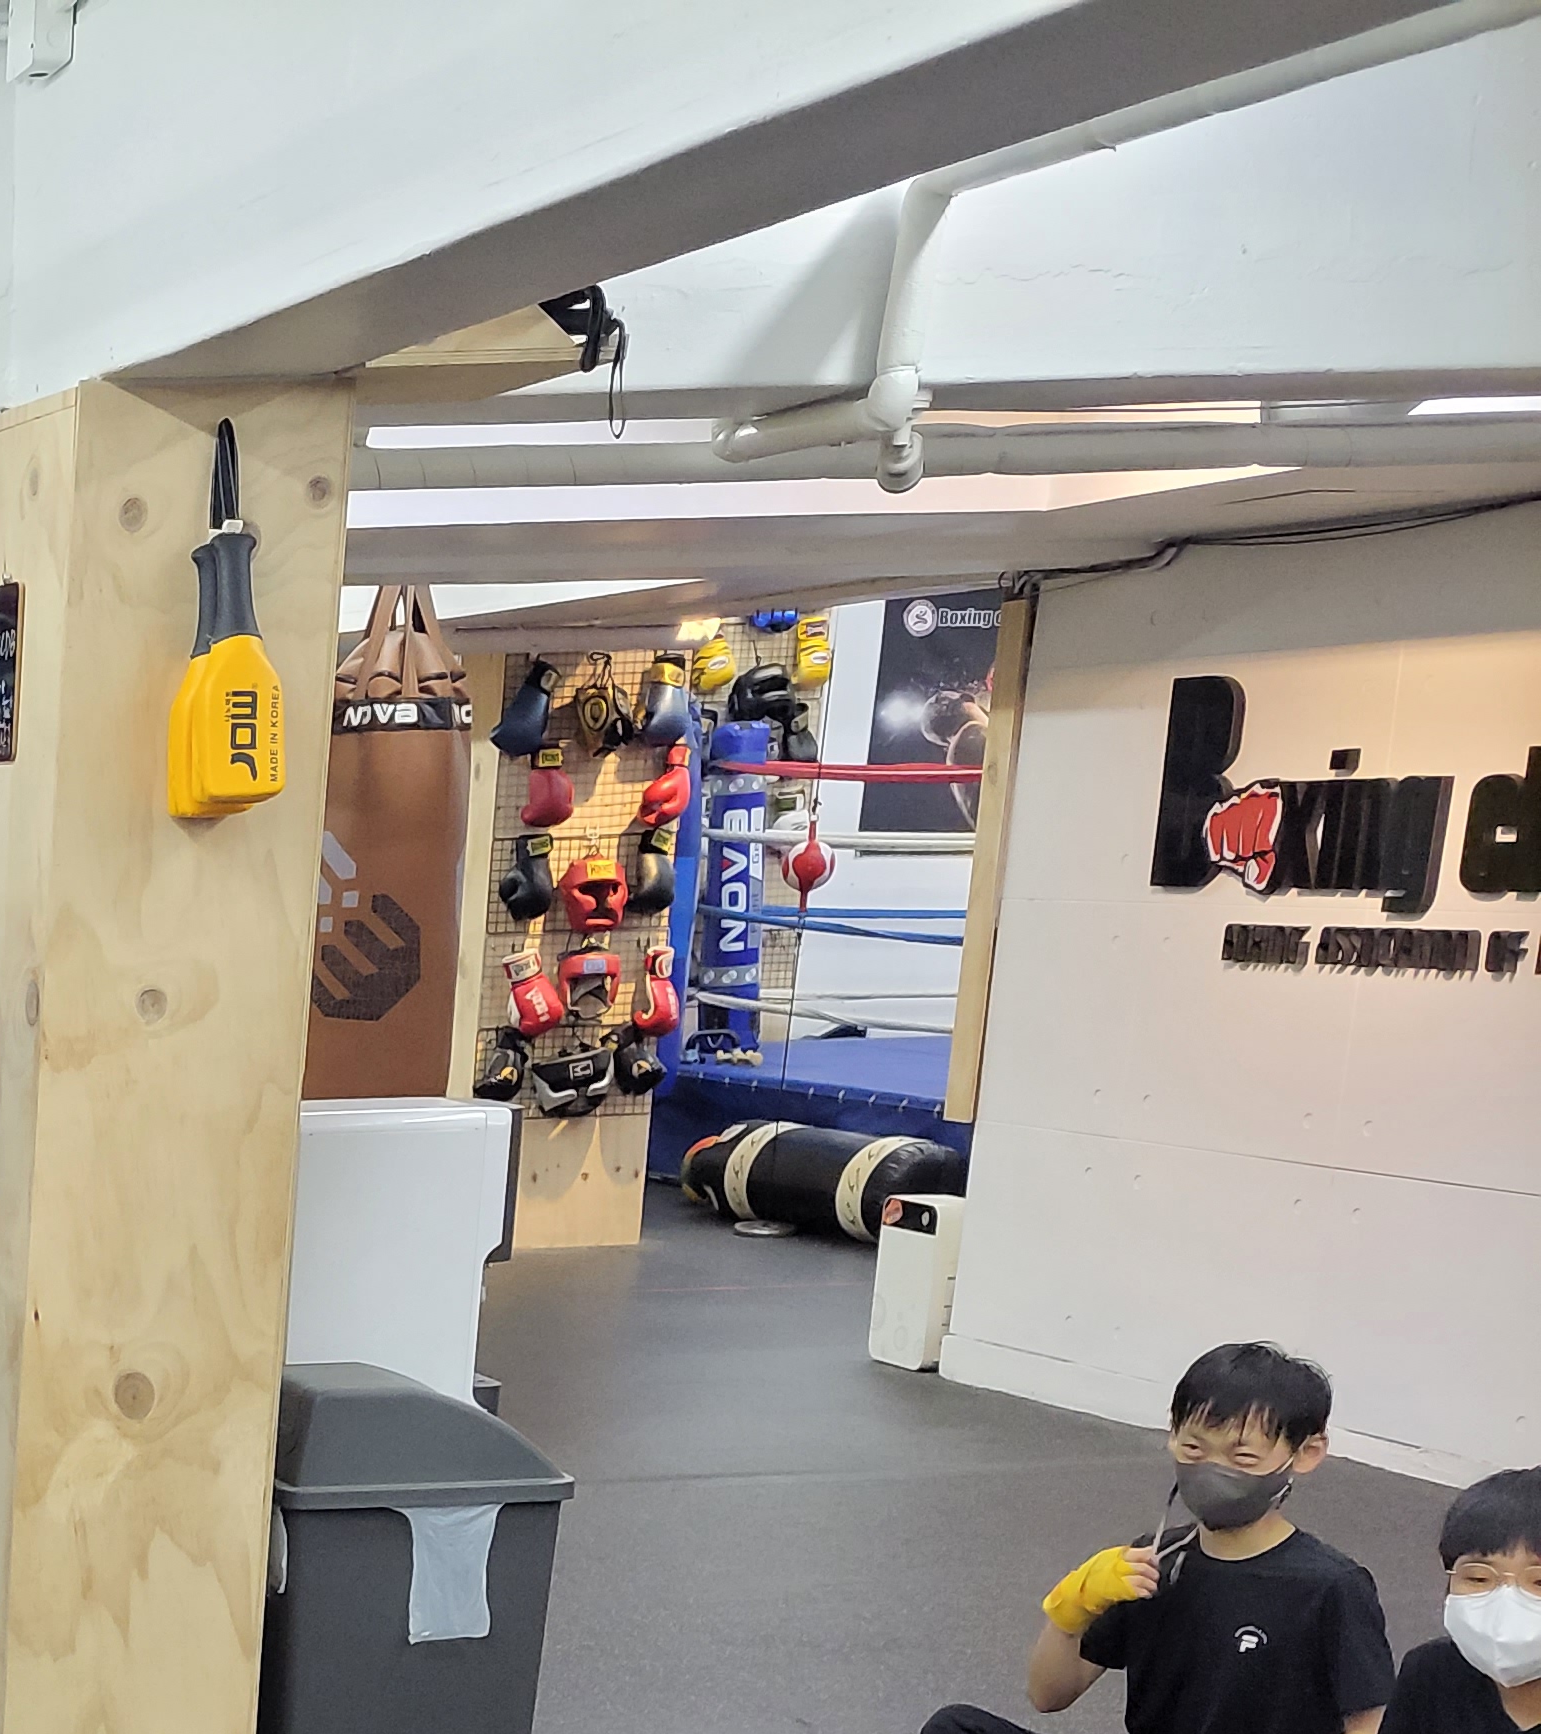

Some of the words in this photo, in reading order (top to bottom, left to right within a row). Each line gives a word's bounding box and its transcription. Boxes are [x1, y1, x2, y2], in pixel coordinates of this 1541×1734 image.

[938, 608, 993, 628] Boxing
[269, 684, 281, 729] KOREA
[269, 732, 279, 745] IN
[269, 748, 279, 782] MADE
[1150, 674, 1454, 914] Bxing
